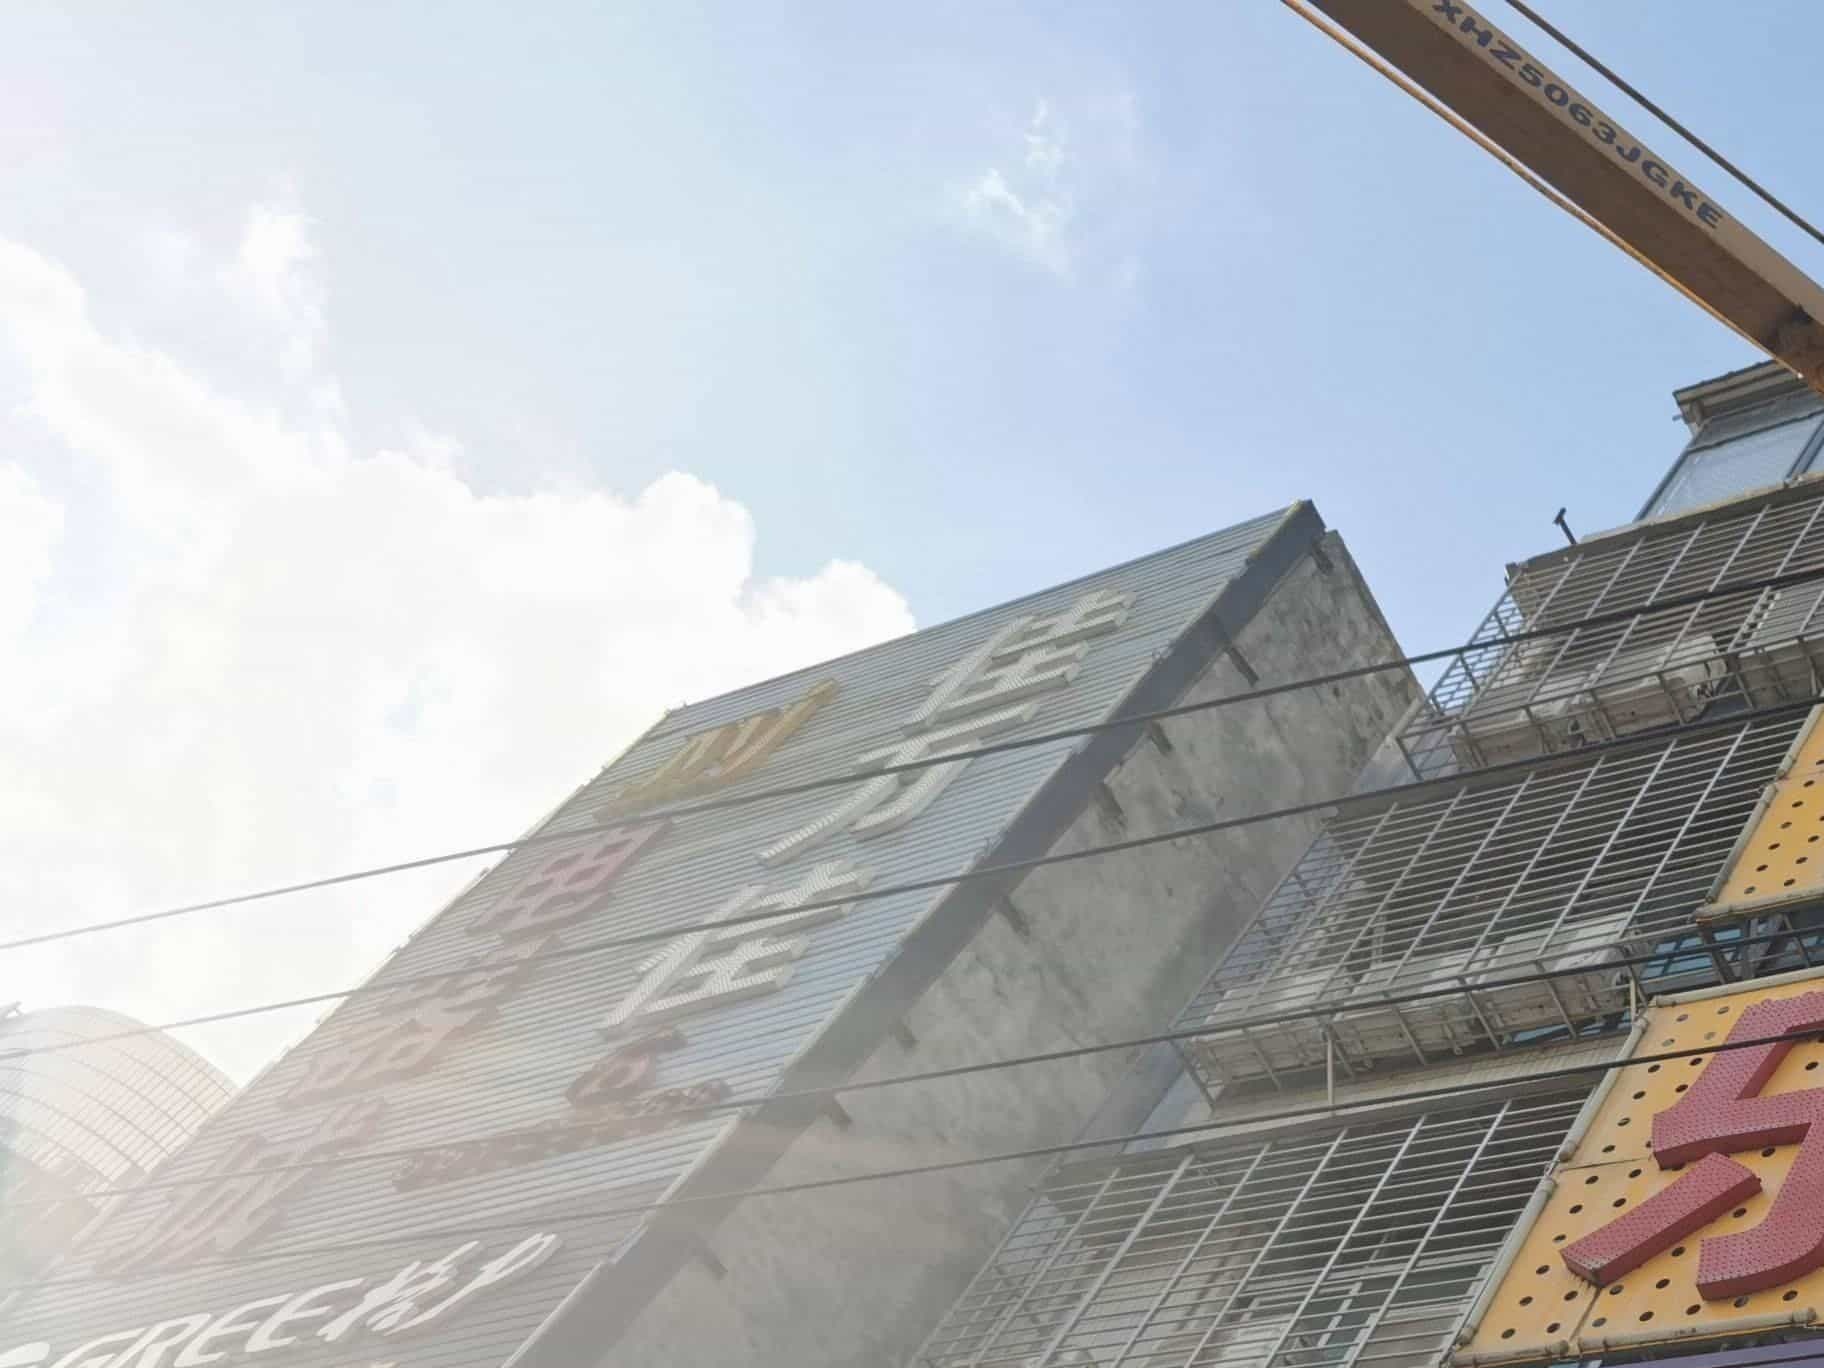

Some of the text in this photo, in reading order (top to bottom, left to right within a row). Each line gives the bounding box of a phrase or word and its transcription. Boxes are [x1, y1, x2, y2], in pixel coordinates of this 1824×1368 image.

[1433, 0, 1722, 229] XHZ5063JGKE
[600, 589, 1138, 1030] 佳万佳
